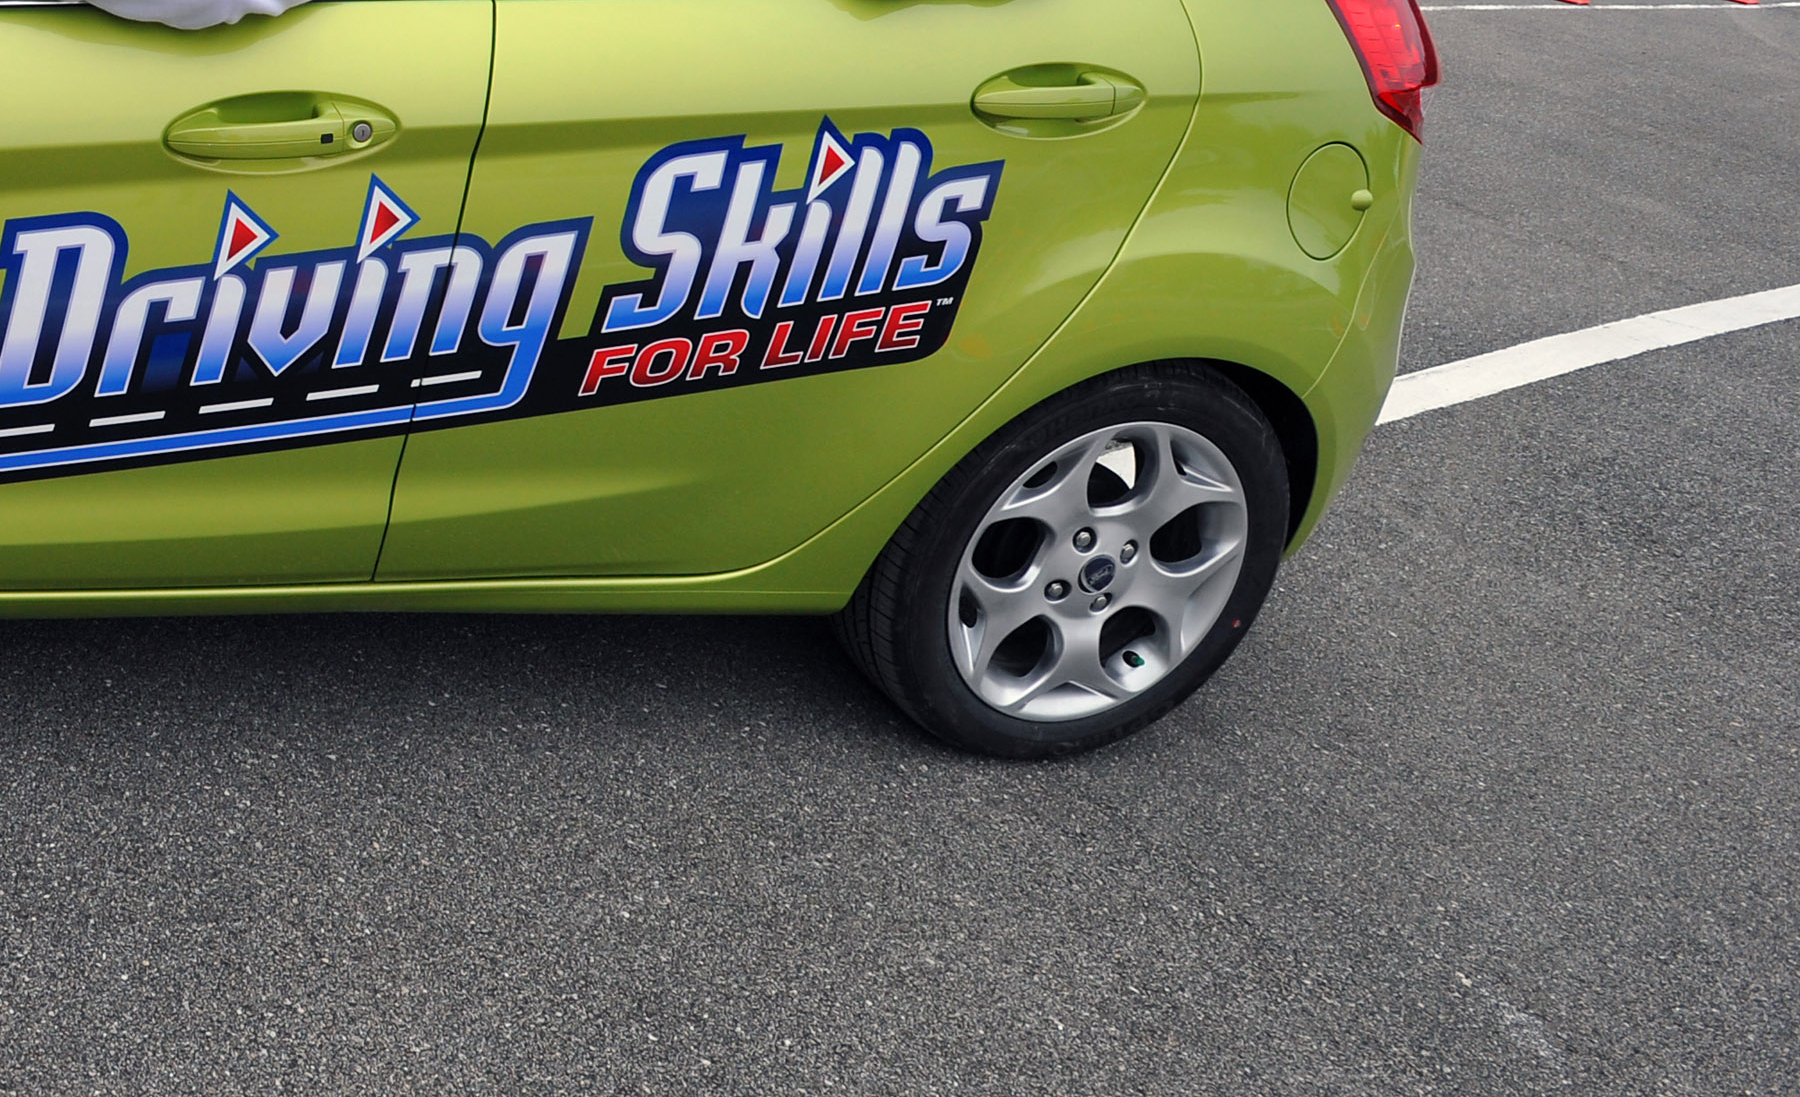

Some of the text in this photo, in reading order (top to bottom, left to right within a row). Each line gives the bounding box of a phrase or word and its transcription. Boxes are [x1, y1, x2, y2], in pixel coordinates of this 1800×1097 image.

[601, 124, 993, 335] Skills
[577, 328, 751, 397] FOR
[760, 299, 934, 370] LIFE
